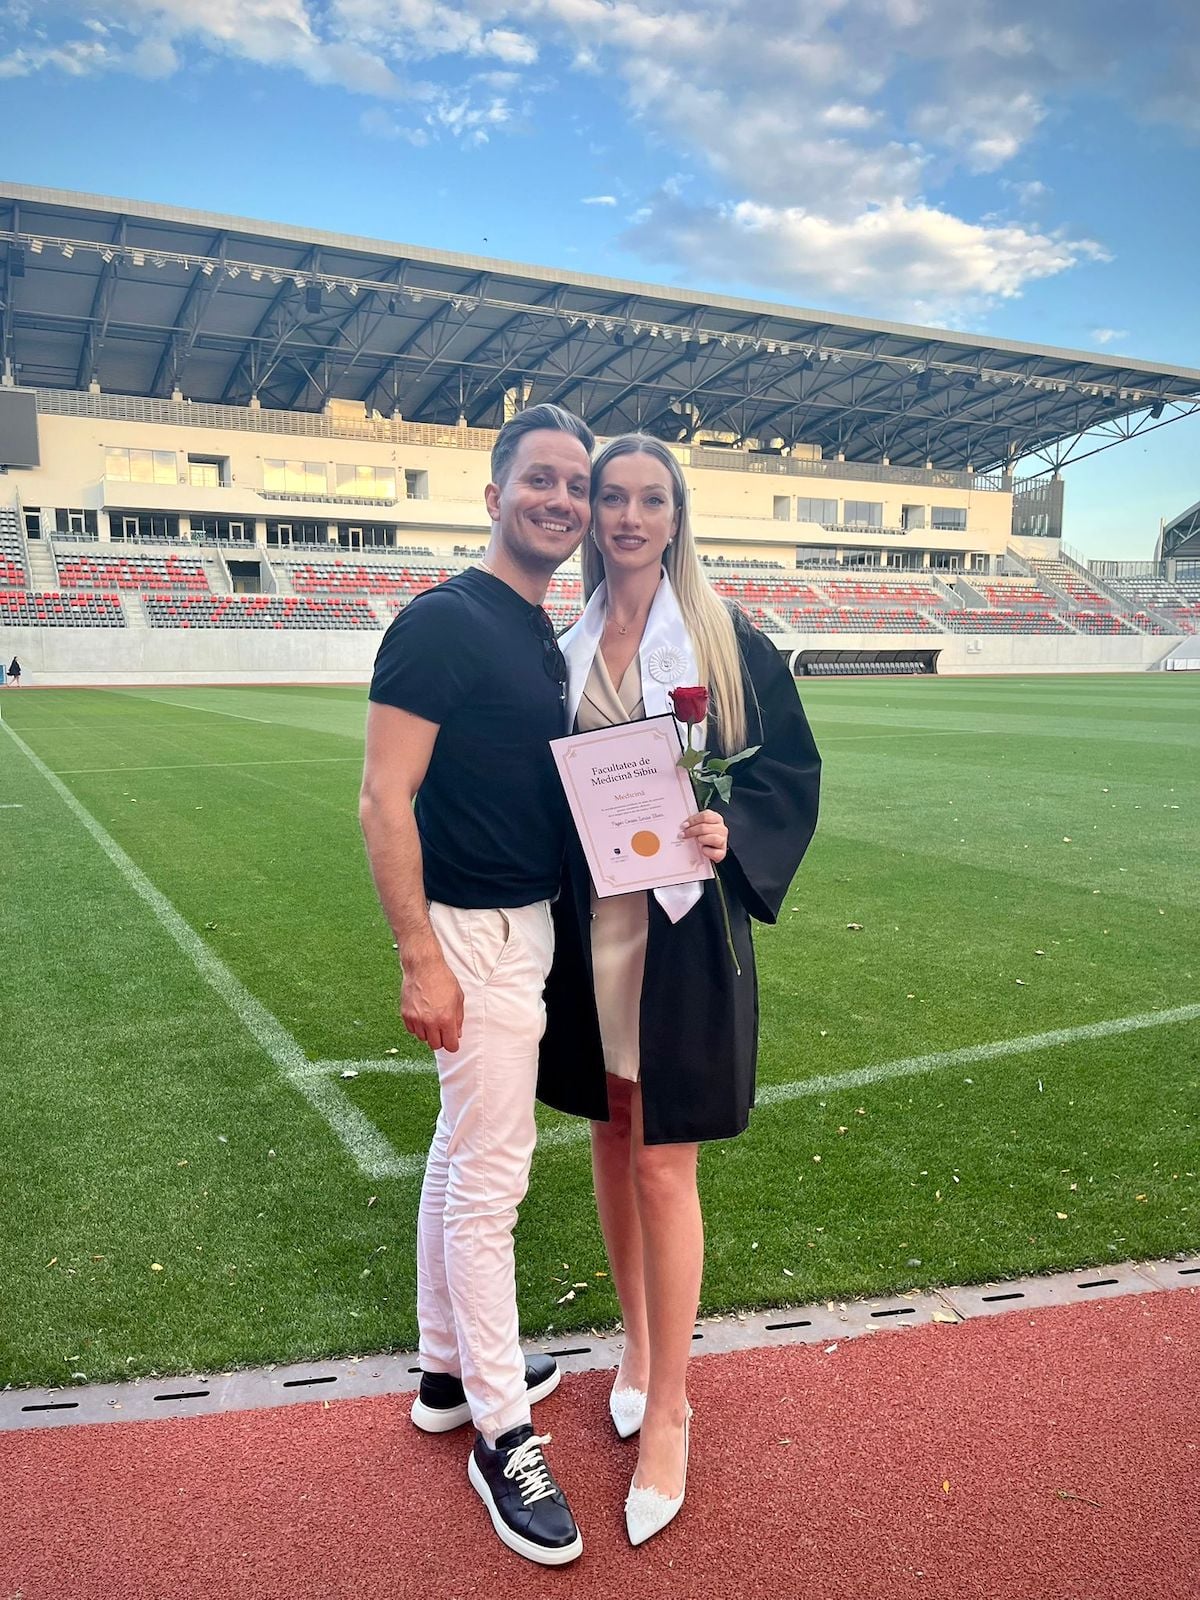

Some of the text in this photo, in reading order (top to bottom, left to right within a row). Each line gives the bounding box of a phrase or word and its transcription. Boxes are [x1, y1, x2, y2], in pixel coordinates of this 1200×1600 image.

[591, 757, 651, 776] Facultatea de
[591, 766, 658, 787] Medicină Sibiu
[614, 790, 646, 802] Medicină
